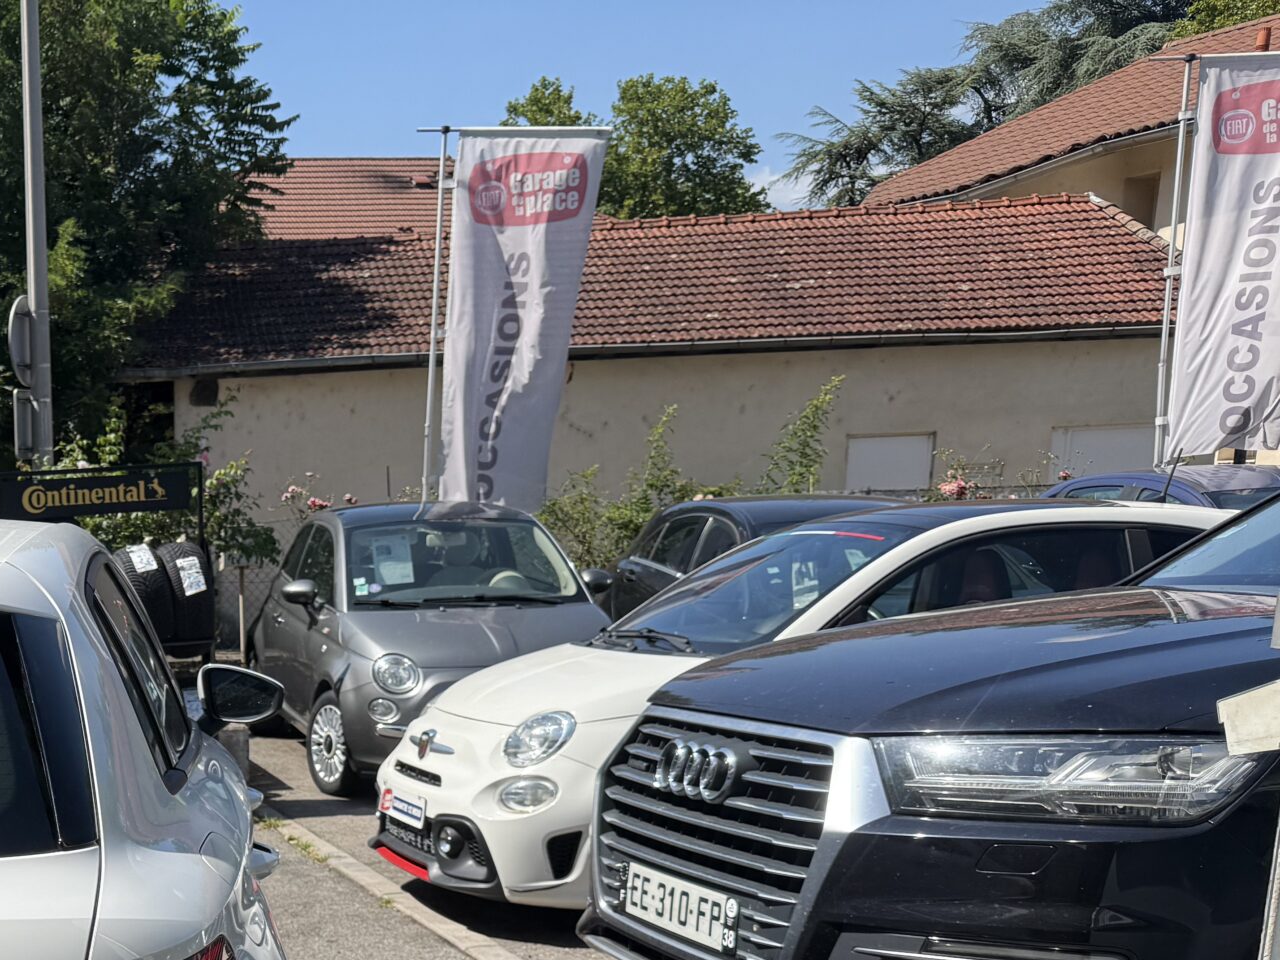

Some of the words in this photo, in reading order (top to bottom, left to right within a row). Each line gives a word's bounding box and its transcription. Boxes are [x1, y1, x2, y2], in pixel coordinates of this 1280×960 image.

[1261, 98, 1280, 122] G
[1227, 118, 1248, 136] FIAT
[1262, 122, 1277, 133] de
[510, 167, 581, 194] Garage
[525, 190, 579, 217] place
[1219, 177, 1280, 435] OCCASIONS
[22, 480, 146, 514] Continental
[628, 872, 722, 937] EE-310-FP
[722, 928, 736, 949] 38
